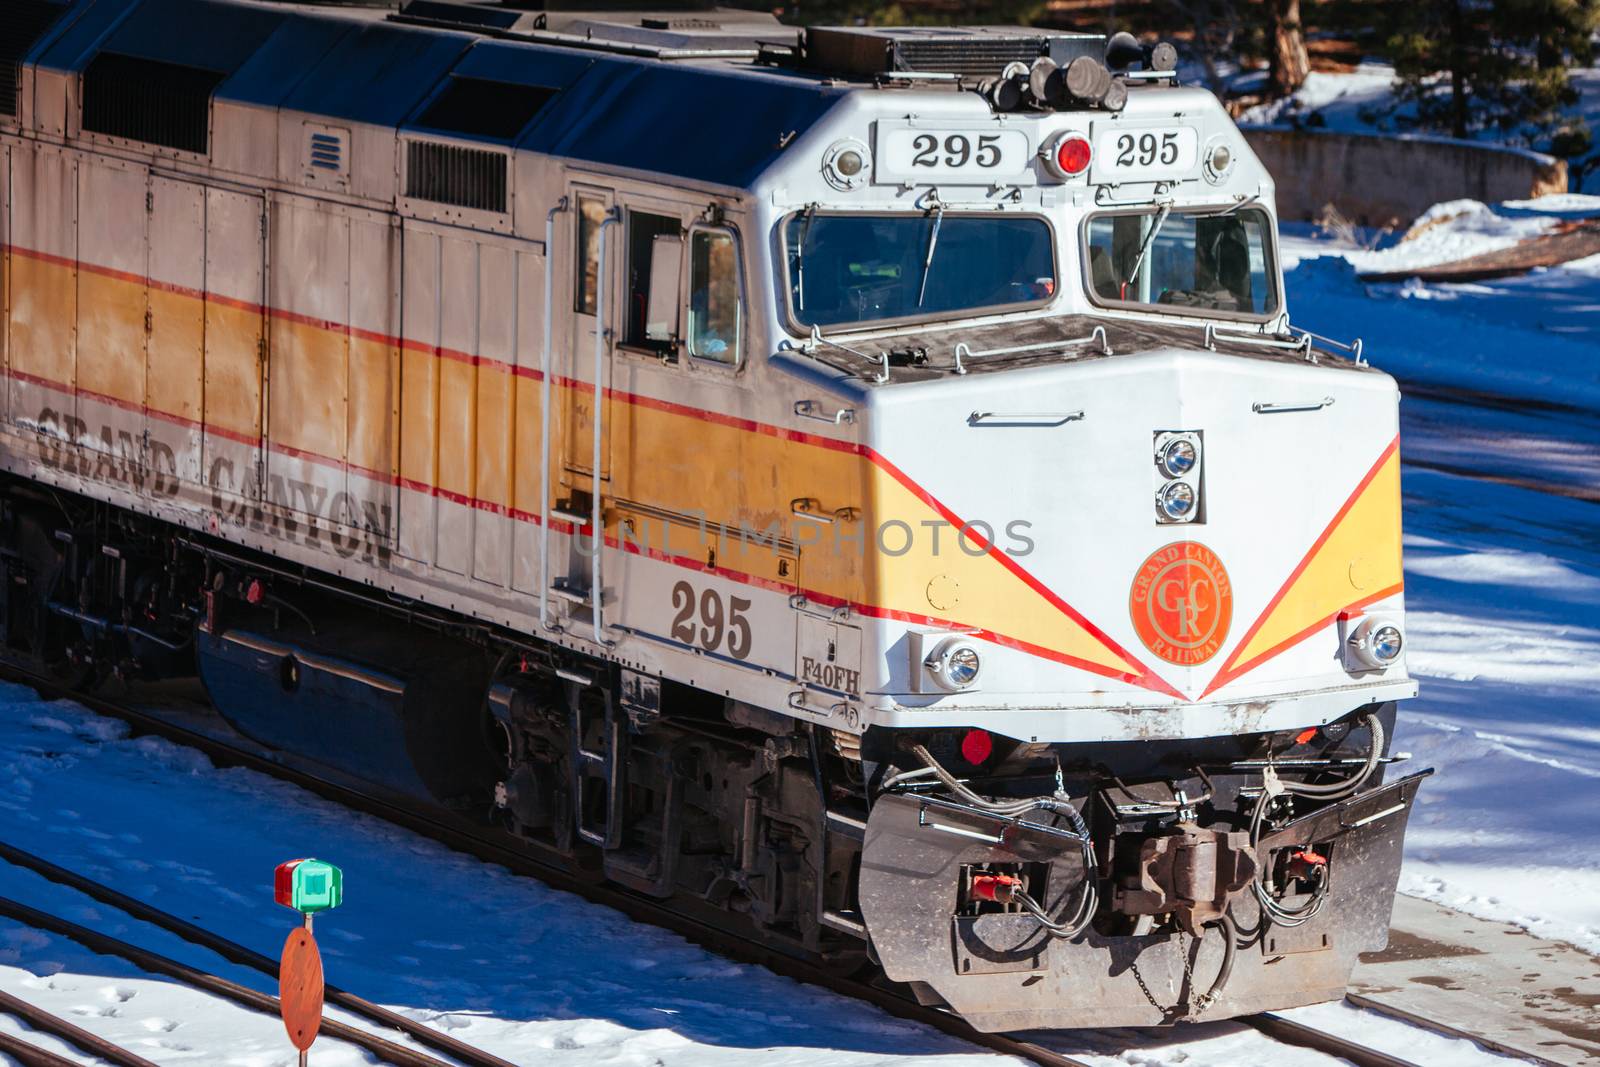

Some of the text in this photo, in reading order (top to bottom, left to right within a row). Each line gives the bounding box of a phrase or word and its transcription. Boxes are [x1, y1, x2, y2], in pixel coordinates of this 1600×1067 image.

[911, 133, 1002, 168] 295
[1116, 132, 1179, 167] 295
[37, 407, 393, 568] GRAND CANYON
[1135, 544, 1231, 603] GRAND CANYON
[671, 580, 752, 660] 295
[1152, 638, 1219, 663] RAILWAY
[801, 656, 860, 696] F40FH
